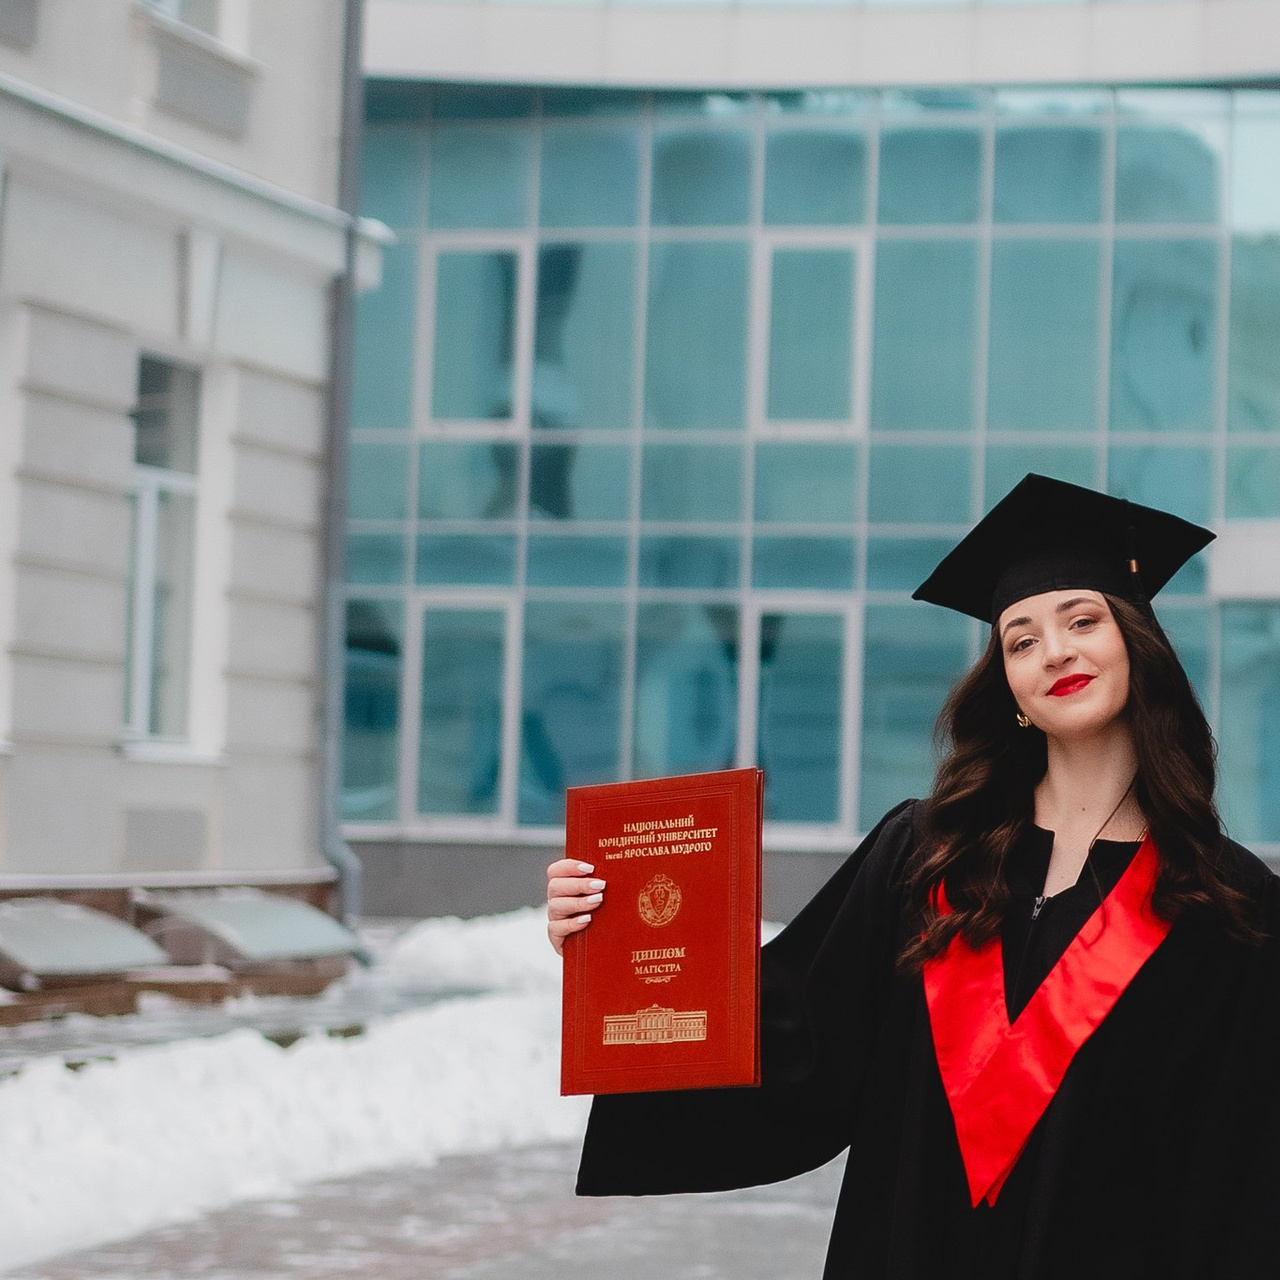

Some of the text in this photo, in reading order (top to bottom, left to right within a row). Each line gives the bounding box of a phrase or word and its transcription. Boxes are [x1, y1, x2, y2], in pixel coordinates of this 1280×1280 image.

[623, 814, 694, 833] НАЦІОНАЛЬНИЙ
[598, 828, 718, 848] ЮРИДИЧНИЙ УНІВЕРСИТЕТ
[624, 846, 670, 859] ЯРОСЛАВА
[671, 841, 712, 854] МУДРОГО
[631, 947, 686, 963] ДИПЛОМ
[635, 963, 681, 975] МАГІСТРА
